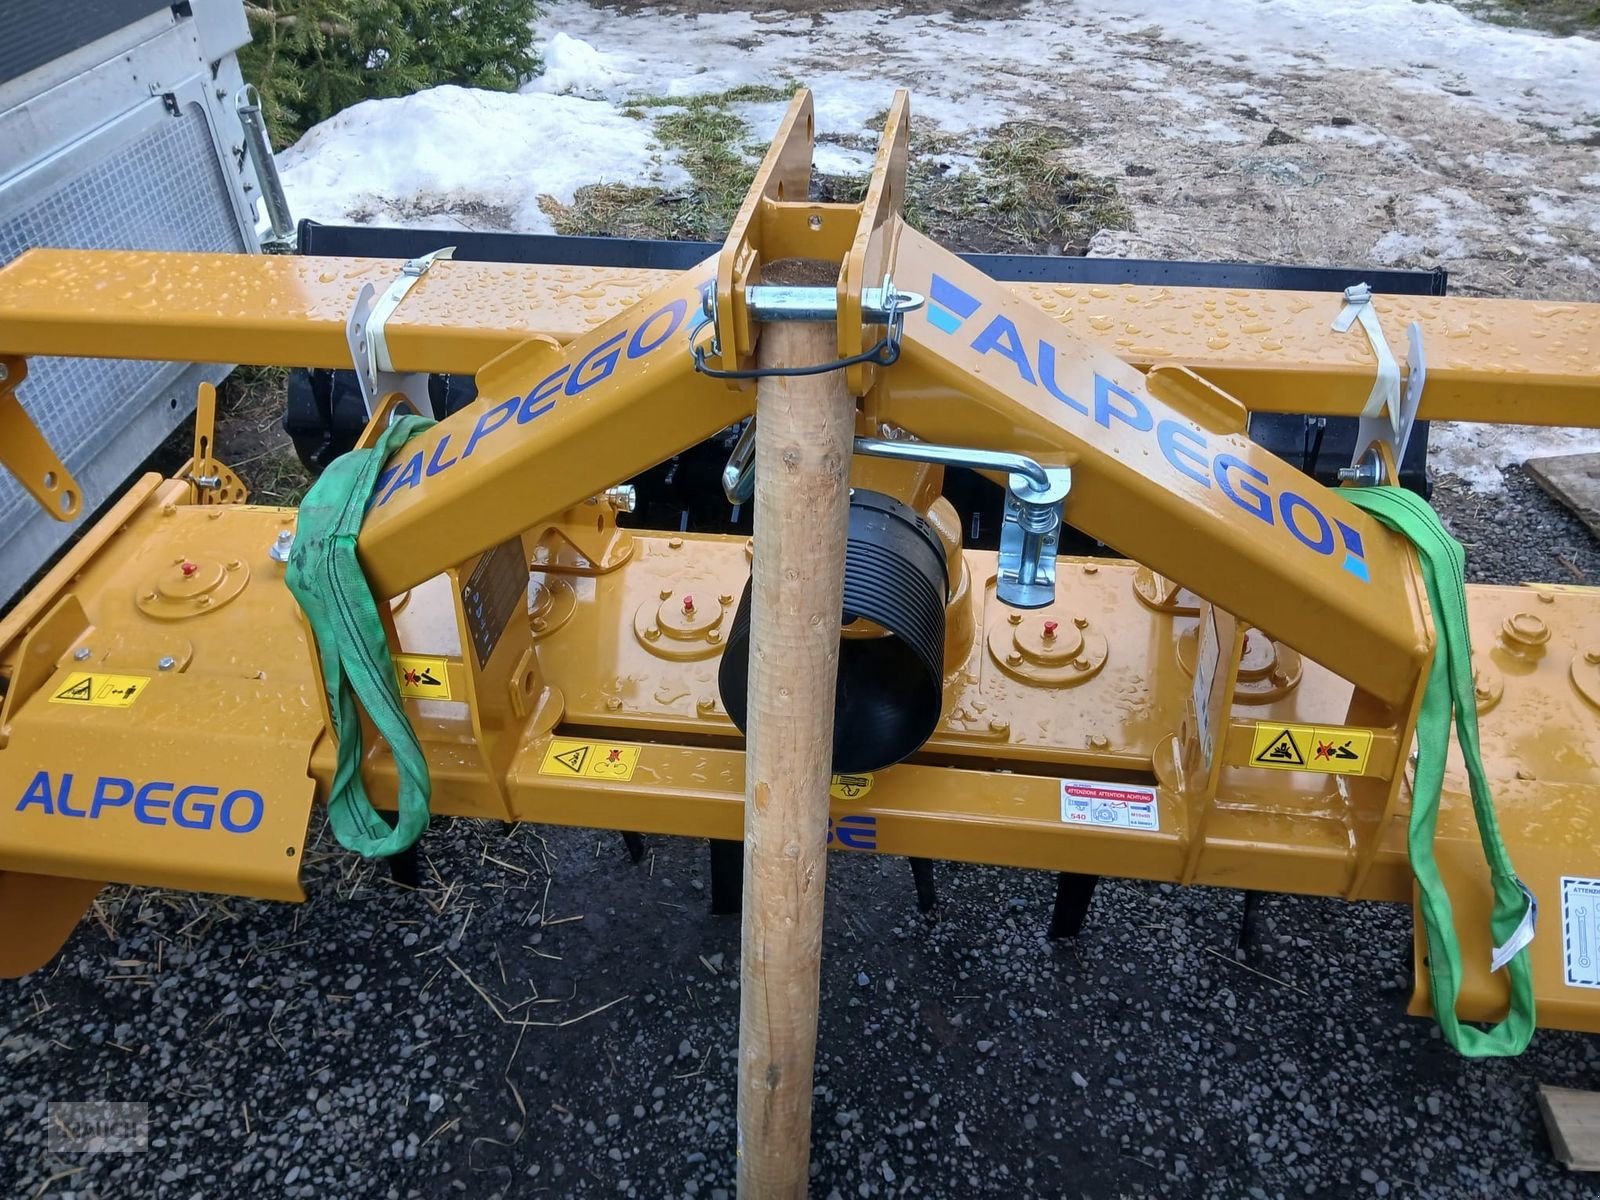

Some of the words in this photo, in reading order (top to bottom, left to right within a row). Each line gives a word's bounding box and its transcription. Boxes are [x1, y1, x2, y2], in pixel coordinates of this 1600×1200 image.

[378, 298, 688, 508] ALPEGO
[970, 313, 1335, 556] ALPEGO
[15, 771, 265, 834] ALPEGO
[1067, 788, 1097, 796] ATTENZIONE
[1098, 790, 1125, 799] ATTENTION
[1127, 793, 1151, 802] ACHTUNG
[1070, 813, 1087, 821] 540
